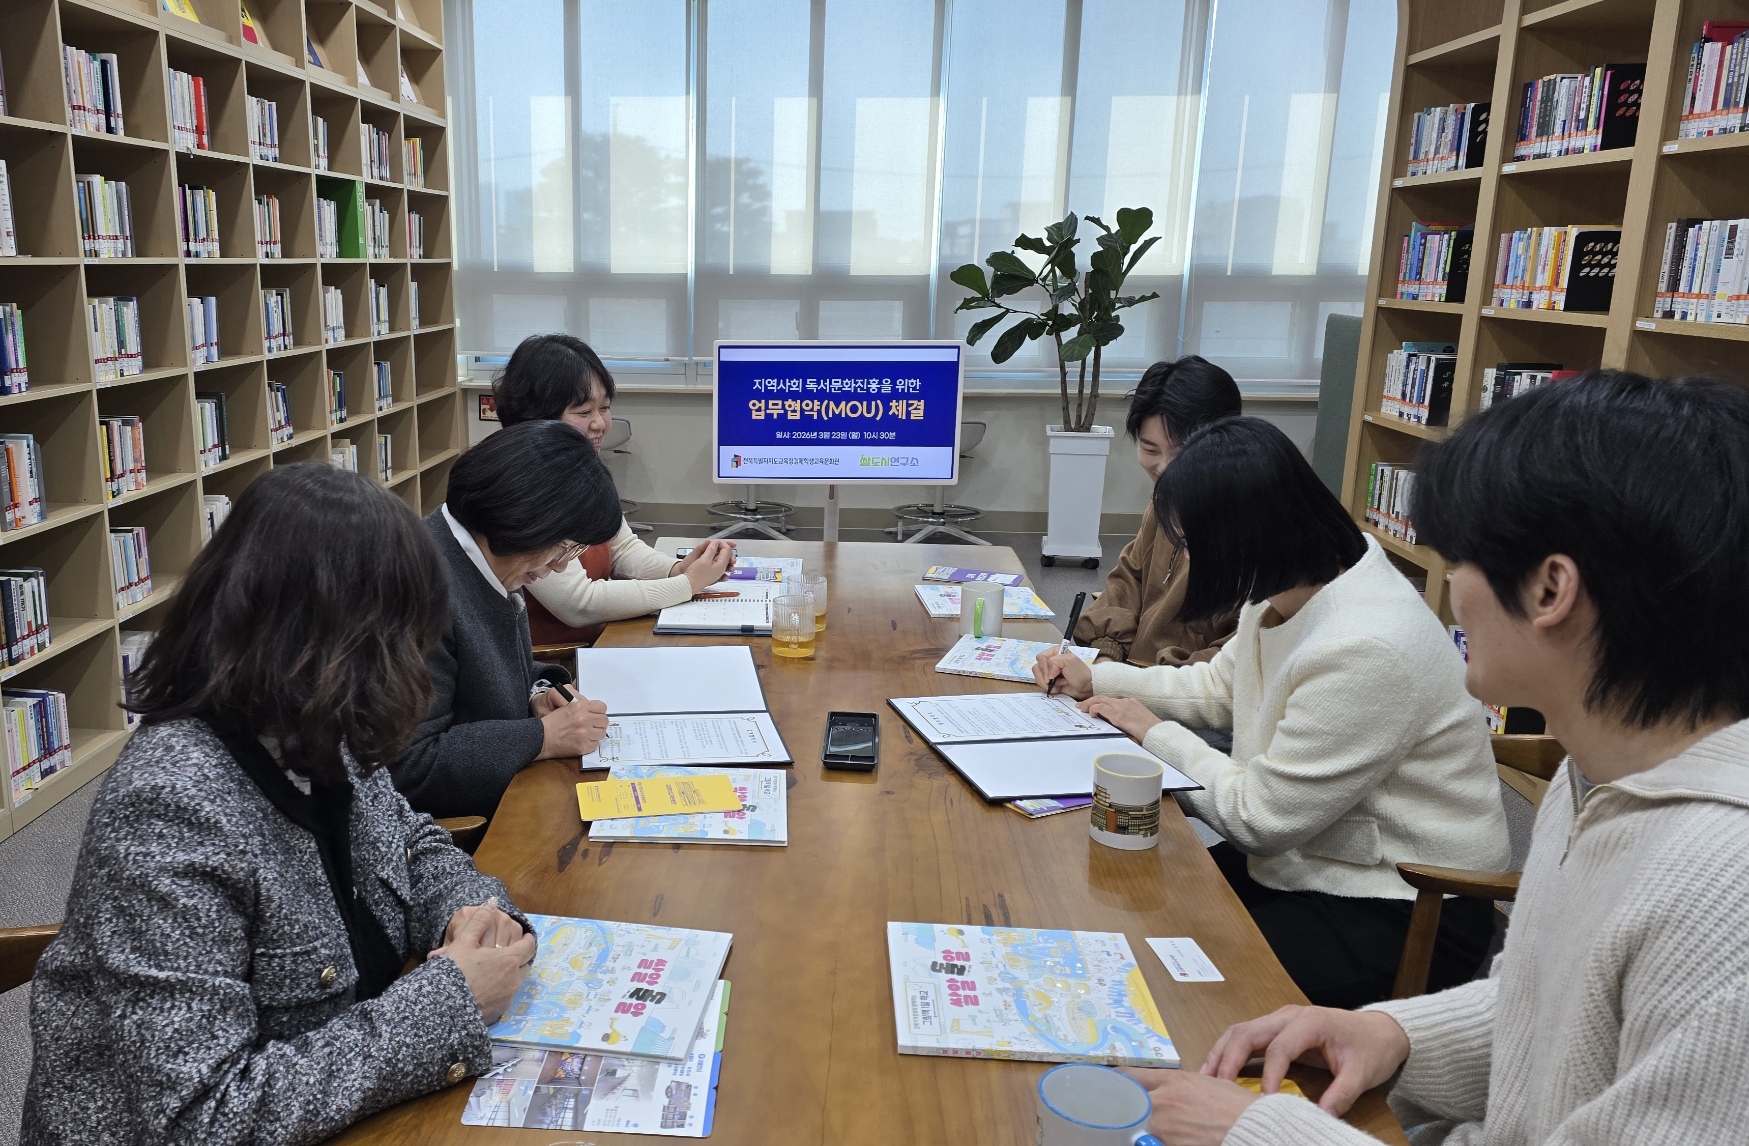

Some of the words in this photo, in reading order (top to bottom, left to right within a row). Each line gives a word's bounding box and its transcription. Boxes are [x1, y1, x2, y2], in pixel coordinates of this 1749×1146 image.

[753, 378, 803, 393] 지역사회
[805, 378, 893, 393] 독서문화진흥을
[895, 378, 921, 393] 위한
[748, 399, 883, 420] 업무협약(MOU)
[889, 399, 925, 420] 체결
[792, 431, 817, 439] 2026년
[831, 431, 847, 439] 23일
[863, 431, 878, 439] 10시
[879, 431, 896, 440] 30분
